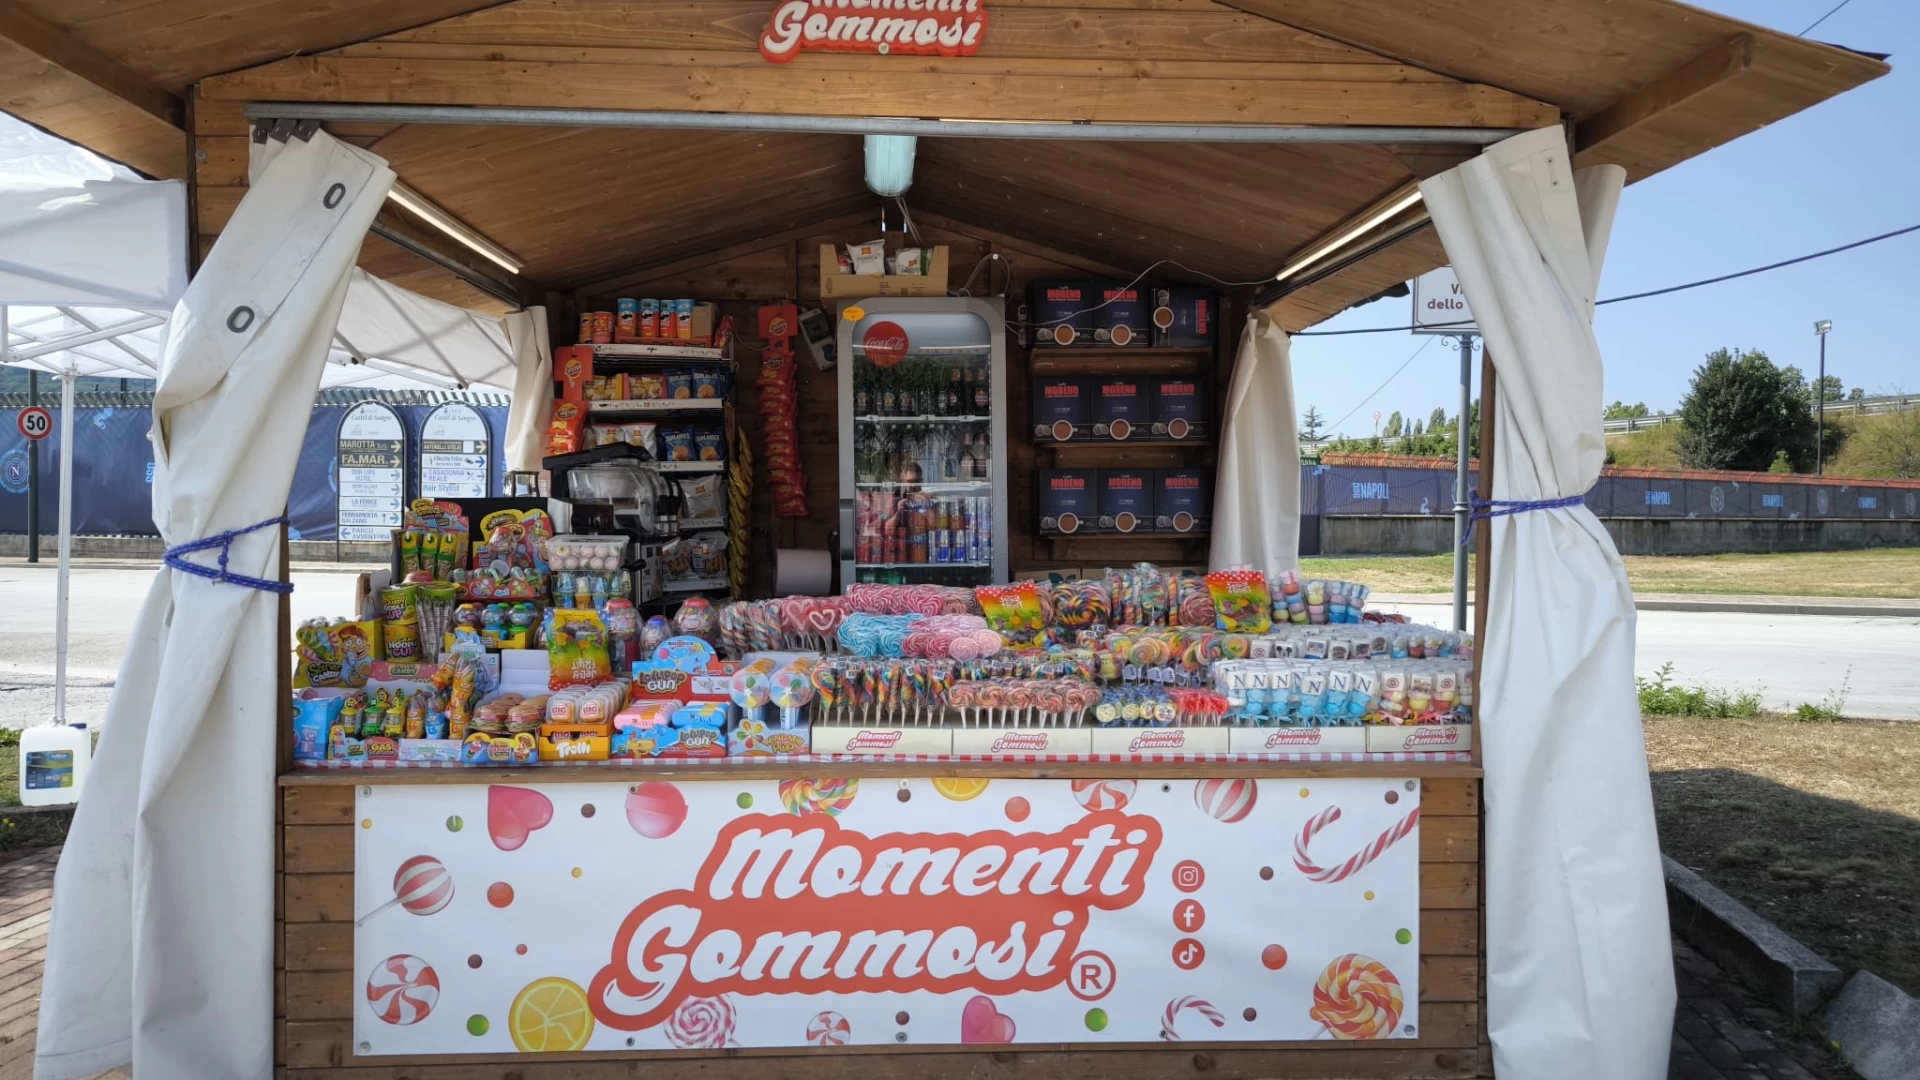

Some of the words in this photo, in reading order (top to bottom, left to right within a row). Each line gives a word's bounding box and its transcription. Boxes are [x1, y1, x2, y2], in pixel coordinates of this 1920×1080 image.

[763, 0, 981, 54] Gommosi
[1047, 289, 1081, 299] MORENO
[1427, 298, 1463, 309] dello
[866, 336, 904, 350] Coca-Cola
[1045, 386, 1079, 396] MORENO
[1102, 385, 1137, 395] MORENO
[1160, 384, 1195, 394] MORENO
[26, 415, 46, 431] 50
[340, 440, 376, 448] MAROTTA
[341, 454, 389, 464] FA.MAR.
[1051, 479, 1085, 488] MORENO
[1108, 478, 1142, 488] MORENO
[1165, 478, 1199, 488] MORENO
[1360, 482, 1389, 499] NAPOLI
[1234, 675, 1245, 687] N
[1254, 674, 1265, 687] N
[1276, 675, 1288, 687] N
[1334, 675, 1346, 689] N
[1357, 678, 1372, 692] N
[1309, 681, 1322, 694] N
[858, 731, 900, 741] Momenti
[1004, 732, 1048, 742] Momenti
[1141, 730, 1185, 740] Momenti
[1278, 727, 1321, 738] Momenti
[1414, 727, 1458, 738] Momenti
[371, 743, 392, 751] GAS
[848, 737, 895, 751] Gommosi
[992, 738, 1048, 752] Gommosi
[1130, 737, 1185, 752] Gommosi
[1265, 734, 1320, 749] Gommosi
[1404, 734, 1458, 749] Gommosi
[556, 741, 591, 758] Trolli
[771, 744, 795, 754] POP
[709, 824, 1150, 900] Momenti
[602, 903, 1076, 1016] Gommosi
